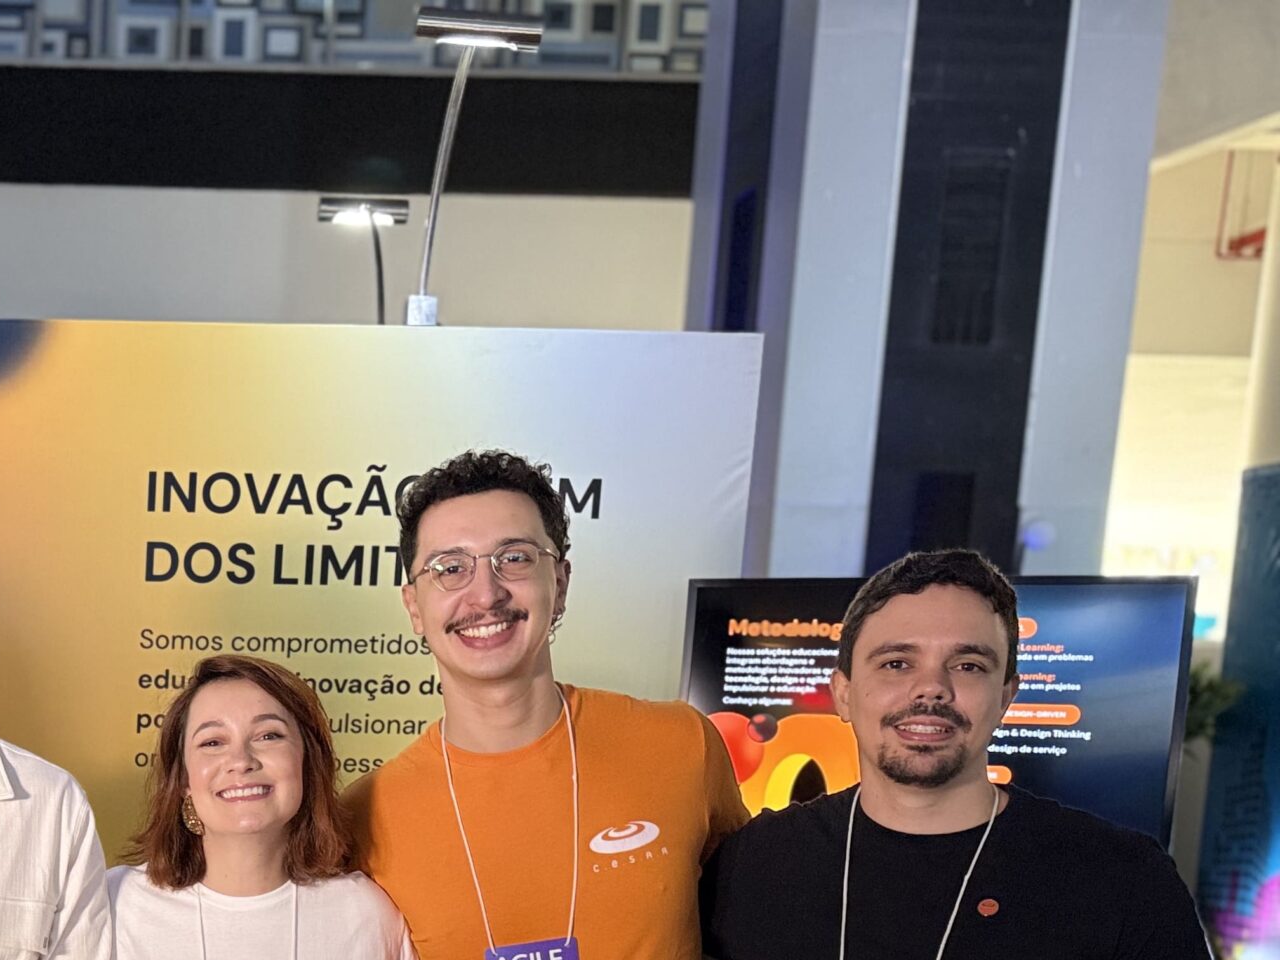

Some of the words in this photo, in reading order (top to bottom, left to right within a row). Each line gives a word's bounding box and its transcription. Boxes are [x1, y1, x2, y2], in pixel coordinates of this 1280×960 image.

[144, 541, 256, 585] DOS
[140, 629, 223, 651] Somos
[231, 633, 431, 658] comprometidos
[295, 672, 410, 701] novação
[1020, 729, 1051, 740] Design
[1052, 729, 1092, 741] Thinking
